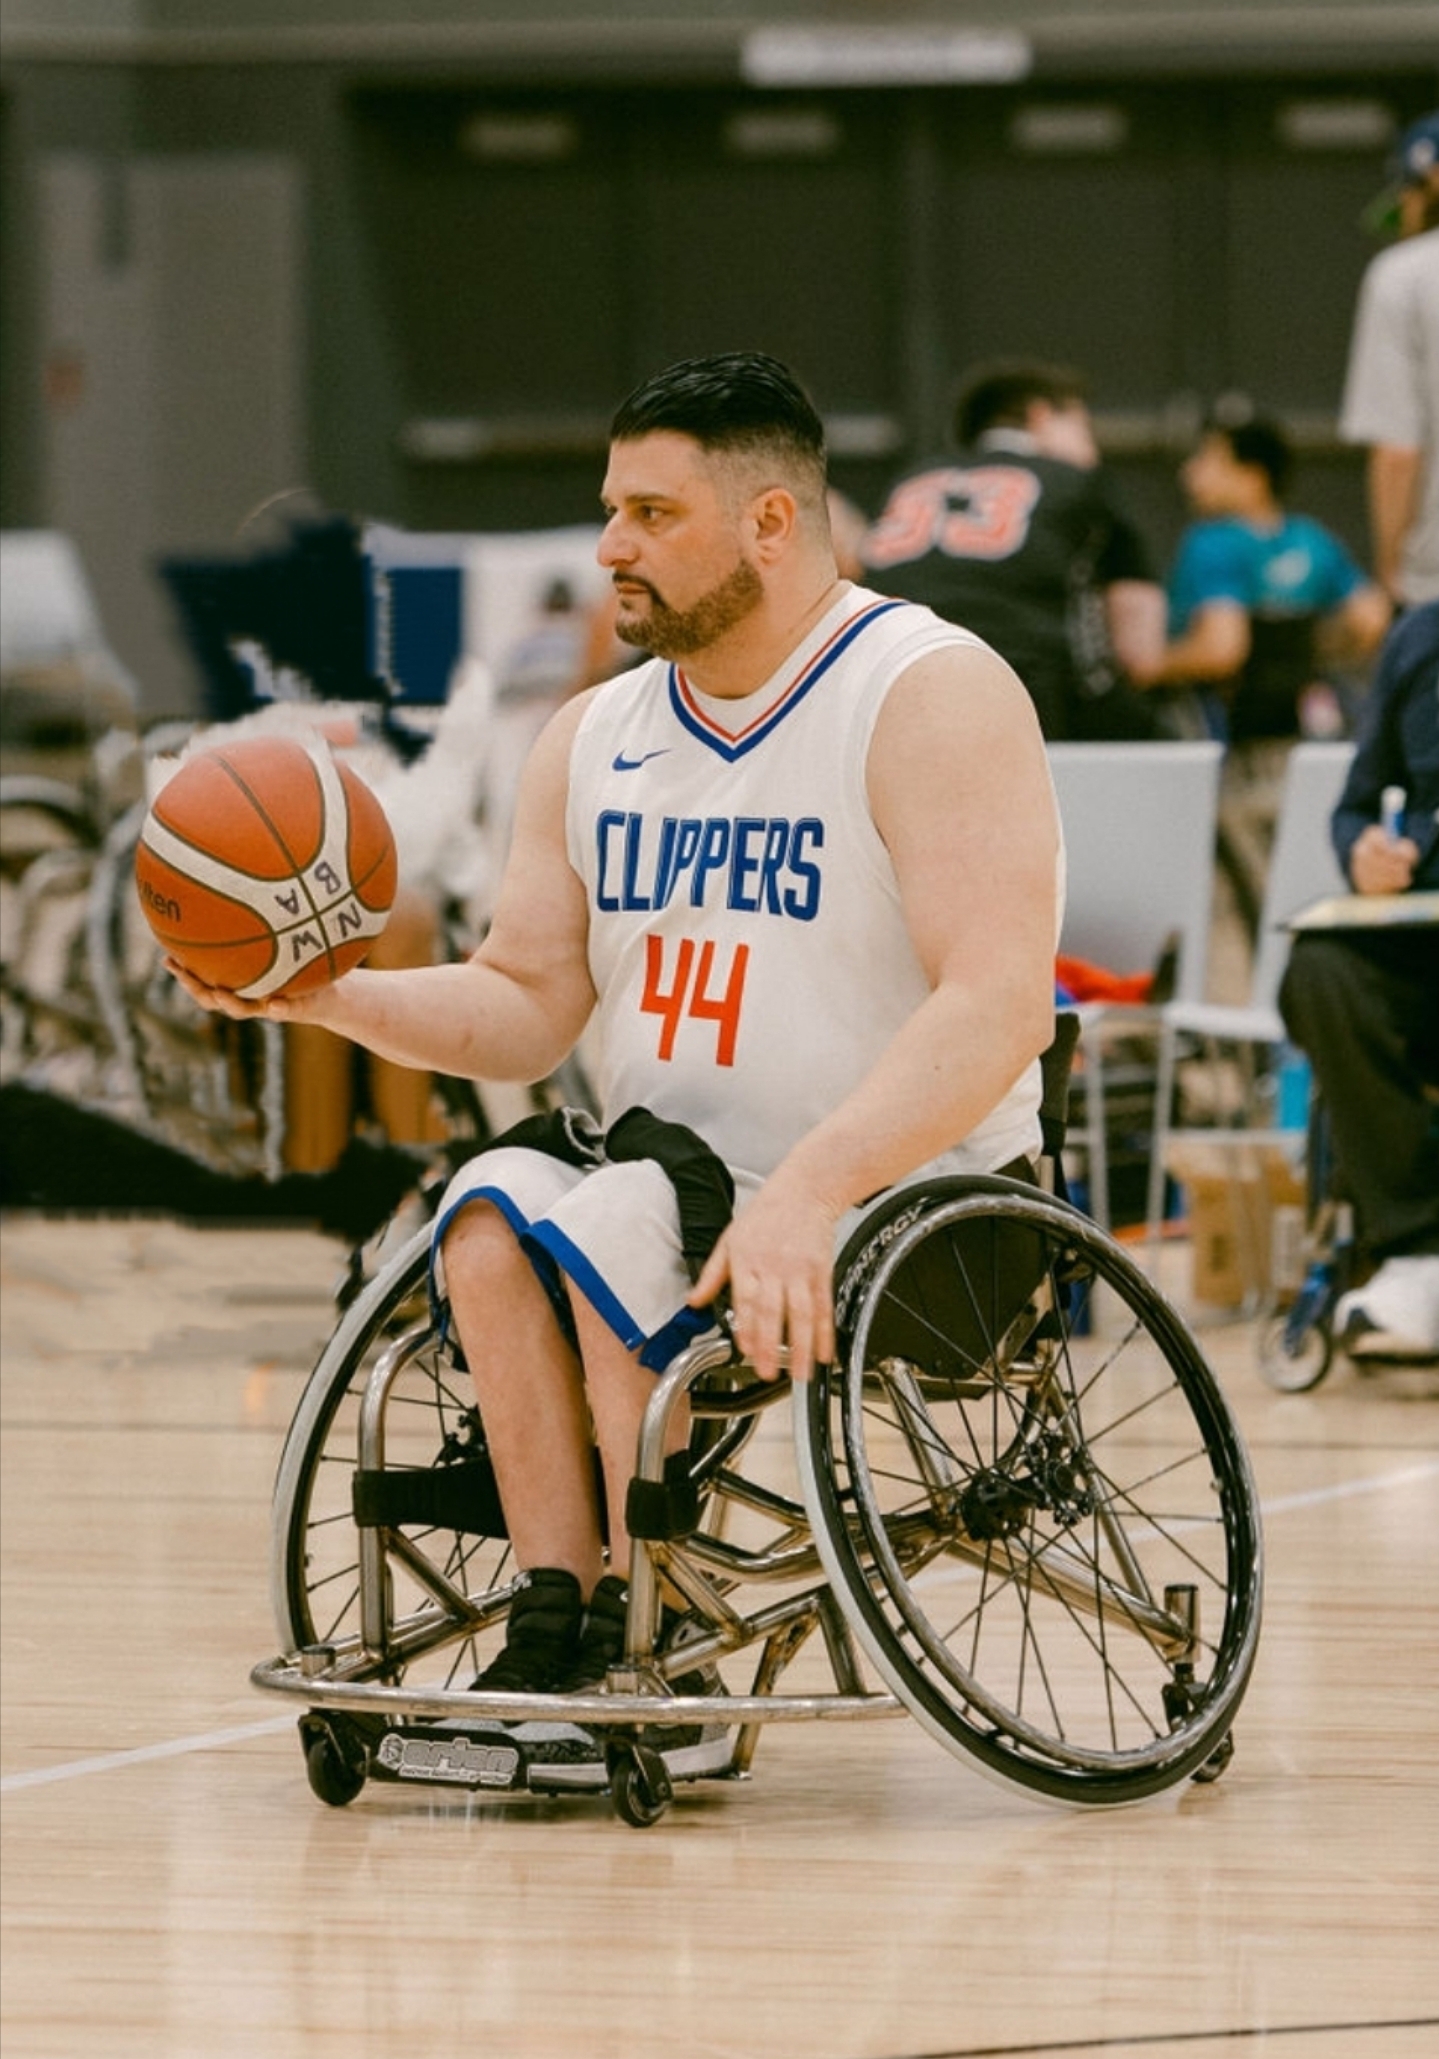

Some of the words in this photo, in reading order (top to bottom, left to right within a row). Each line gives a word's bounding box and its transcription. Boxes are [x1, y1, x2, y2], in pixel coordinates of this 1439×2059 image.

[314, 861, 341, 895] B
[597, 809, 824, 921] CLIPPERS
[274, 889, 300, 915] A
[640, 934, 750, 1067] 44
